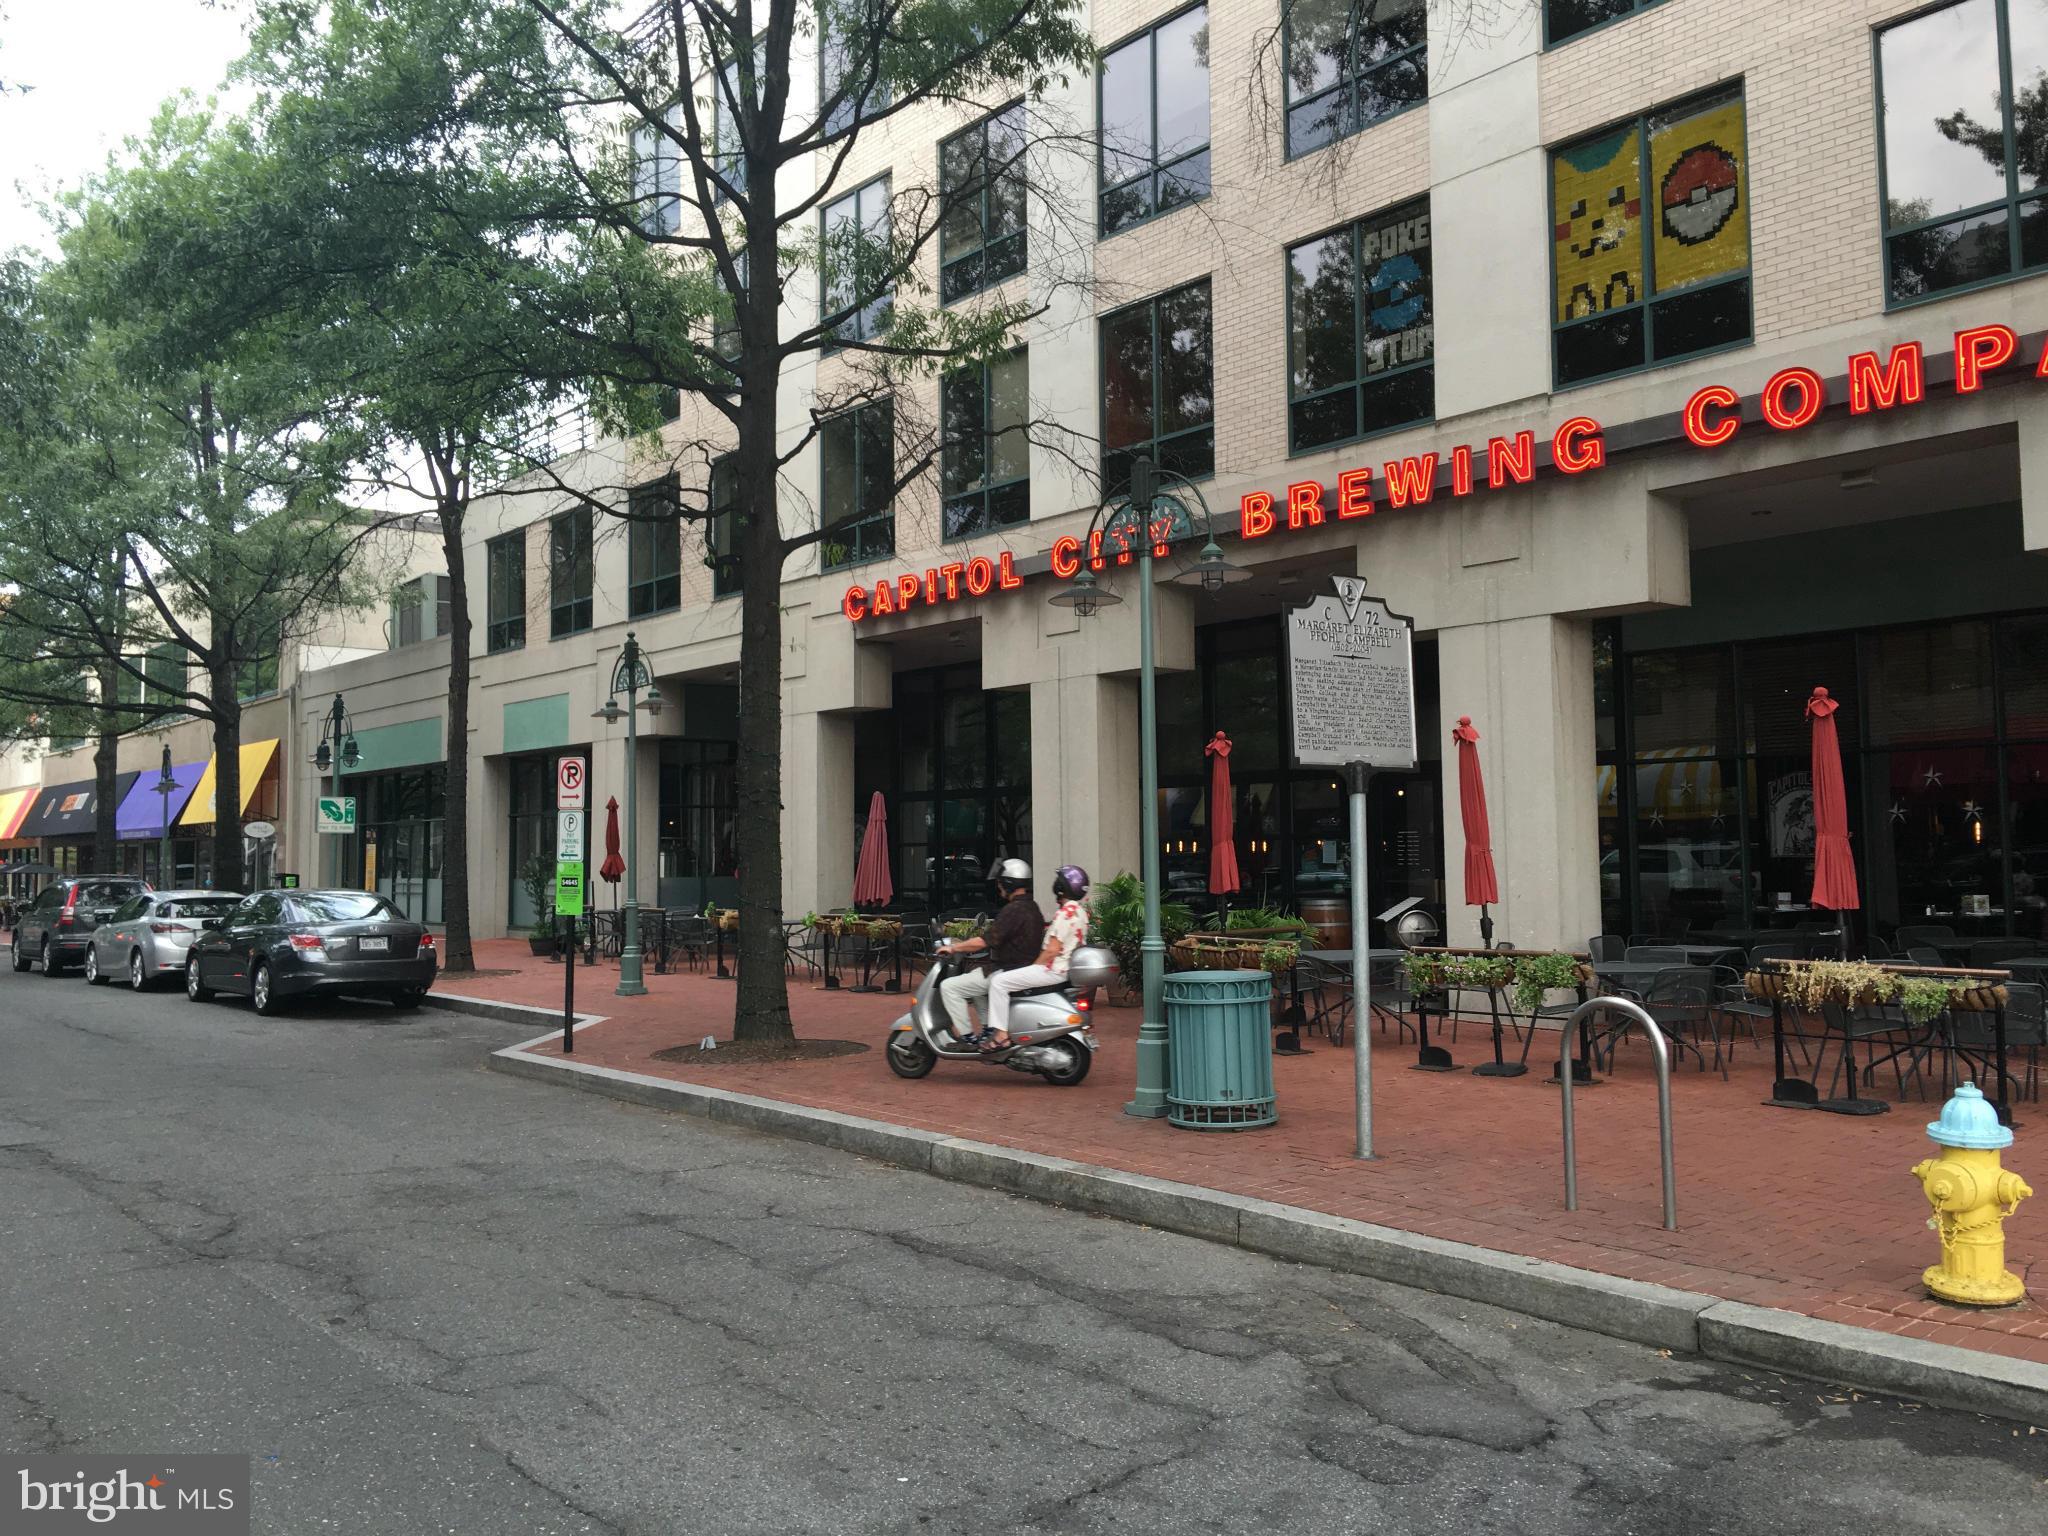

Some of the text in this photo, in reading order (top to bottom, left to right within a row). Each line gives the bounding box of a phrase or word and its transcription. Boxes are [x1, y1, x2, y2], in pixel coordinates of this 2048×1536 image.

[845, 552, 1024, 622] CAPITOL
[1241, 416, 1606, 540] BREWING
[1683, 324, 2048, 447] COMP
[1324, 606, 1379, 626] C 72
[1298, 618, 1401, 639] MARGARET ELIZABETH
[1310, 630, 1391, 648] PFOHL CAMPBELL
[346, 800, 354, 808] 2
